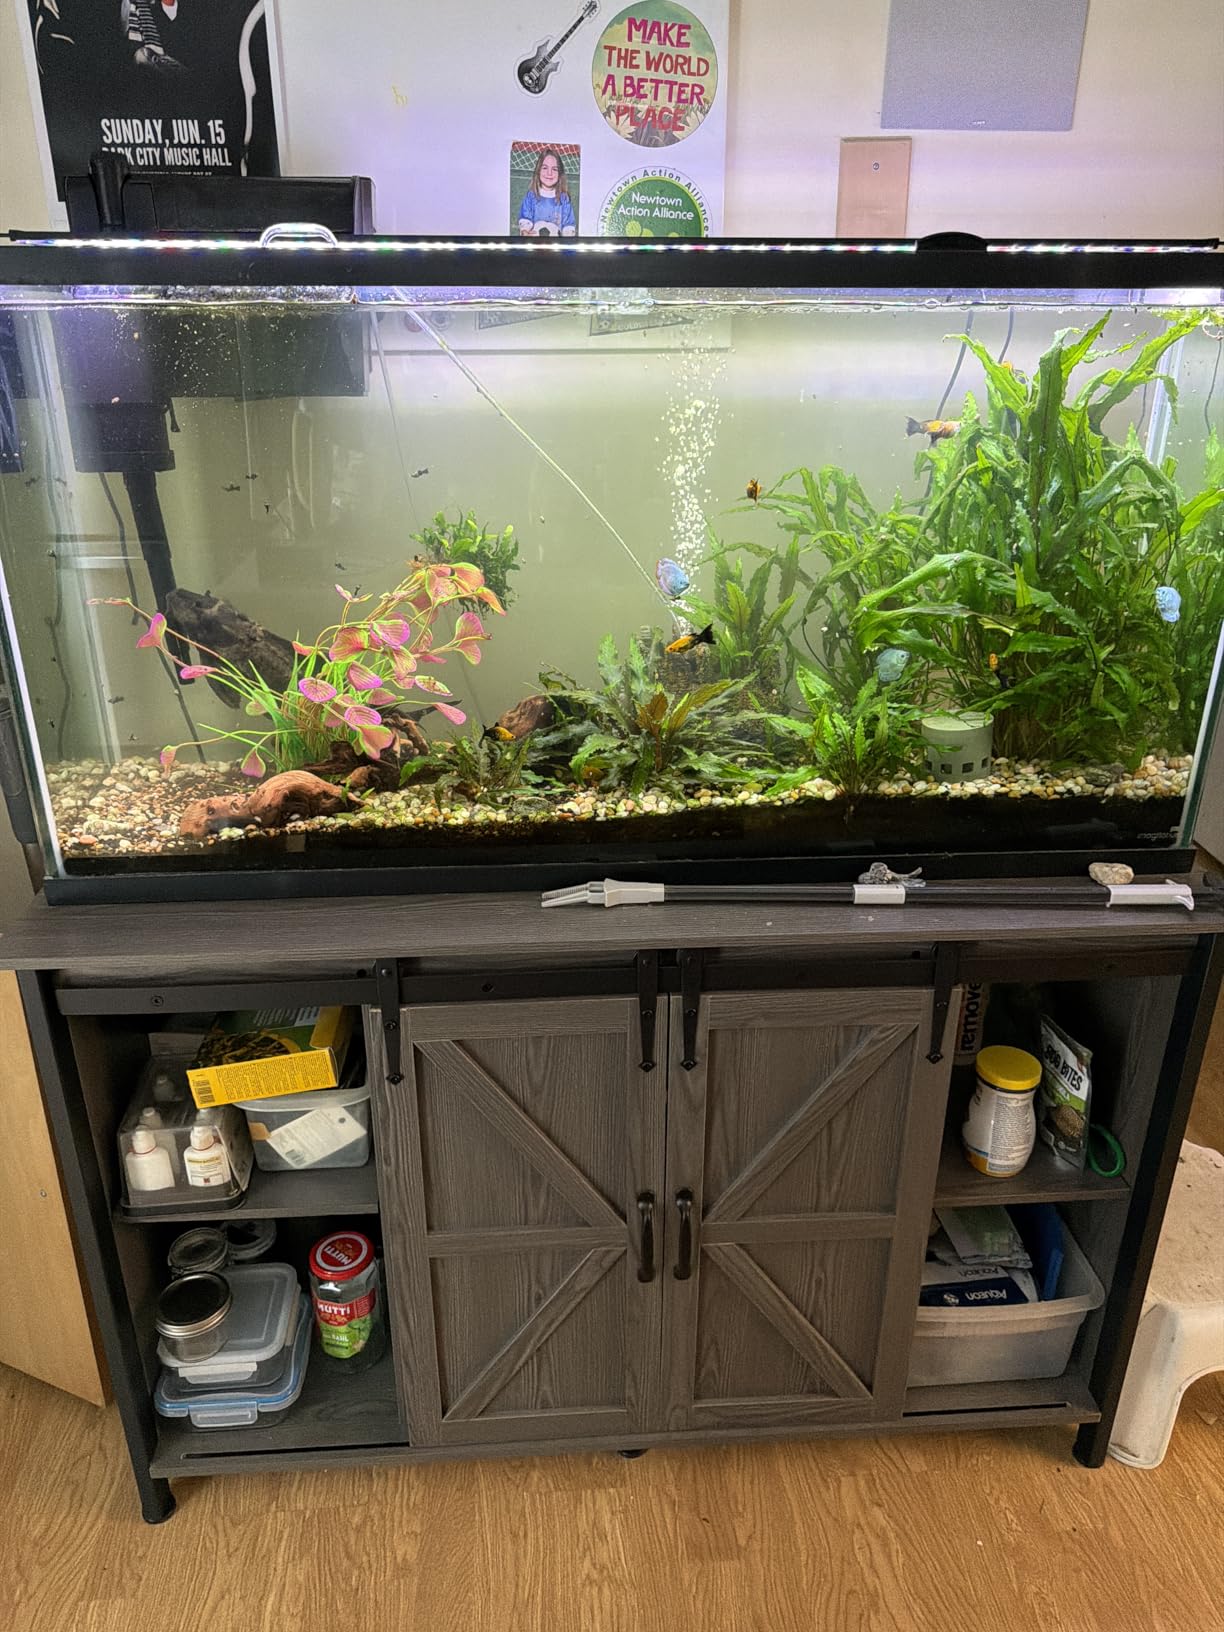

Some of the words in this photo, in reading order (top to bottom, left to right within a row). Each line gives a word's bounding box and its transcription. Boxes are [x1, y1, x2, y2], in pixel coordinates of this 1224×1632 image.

[627, 17, 691, 48] MAKE
[603, 45, 641, 70] THE
[645, 51, 710, 77] WORLD
[602, 74, 617, 97] A
[623, 76, 705, 106] BETTER
[100, 118, 170, 148] SUNDAY,
[172, 119, 206, 144] JUN.
[207, 119, 226, 144] 15
[616, 105, 686, 131] PLACE
[135, 147, 161, 166] CITY
[163, 147, 201, 167] MUSIC
[202, 147, 232, 167] HALL
[601, 175, 638, 223] Newtown
[642, 169, 681, 183] Action
[685, 181, 710, 232] Alliance
[618, 204, 650, 217] Action
[652, 207, 695, 221] Alliance
[631, 192, 683, 207] Newtown
[1060, 1059, 1084, 1092] BITES
